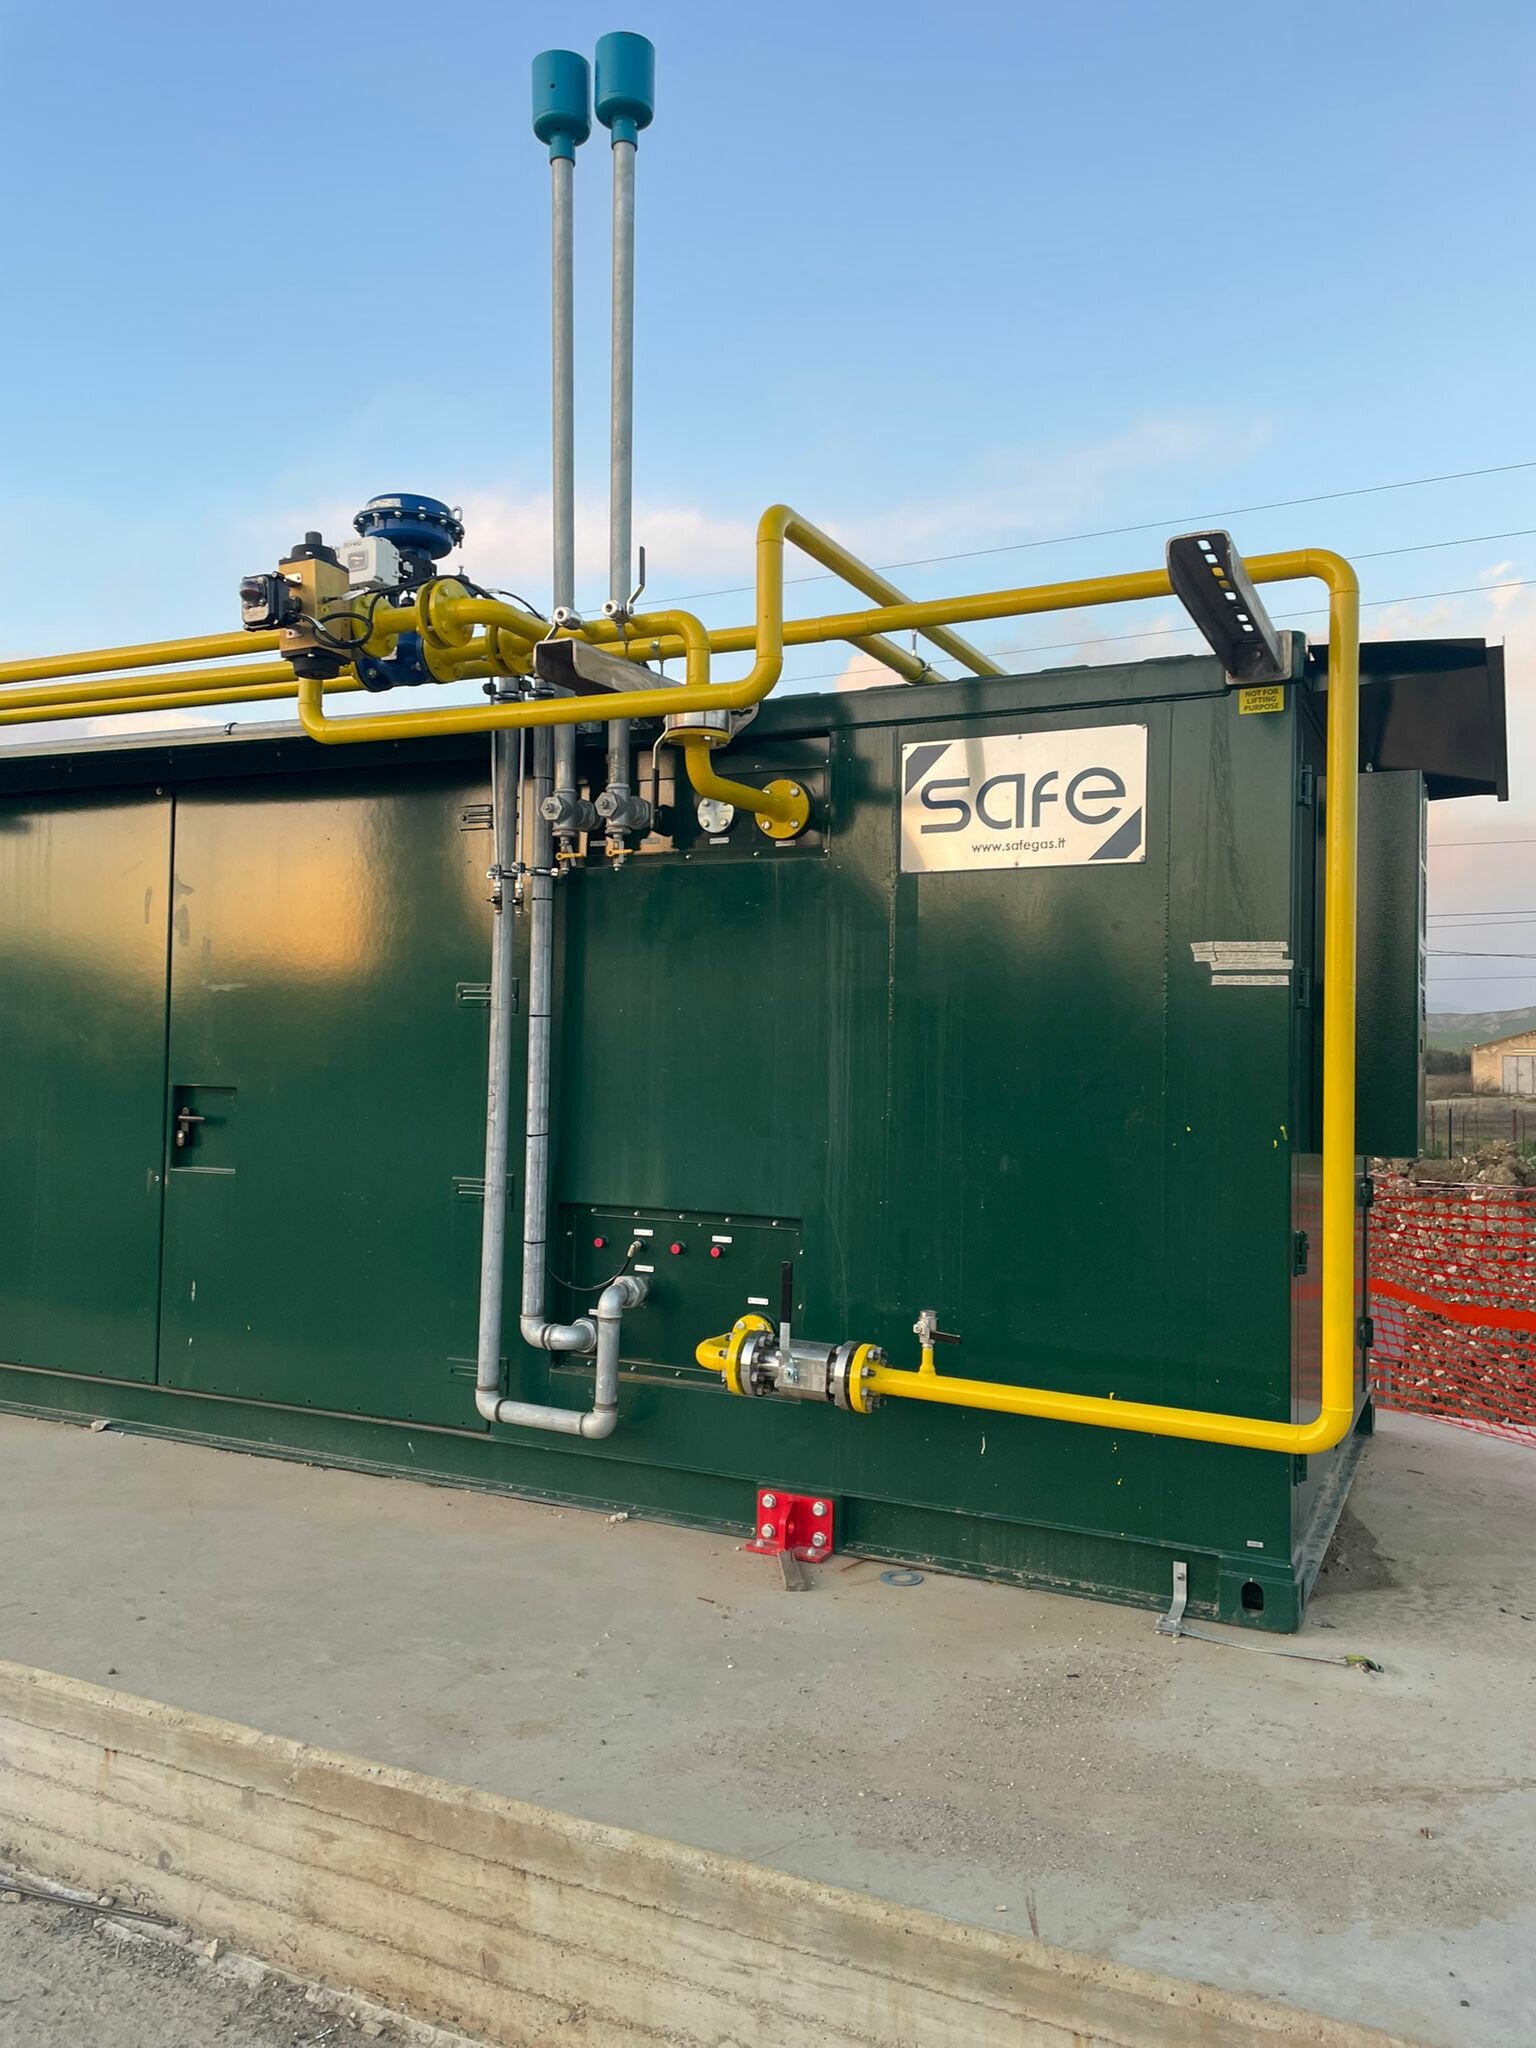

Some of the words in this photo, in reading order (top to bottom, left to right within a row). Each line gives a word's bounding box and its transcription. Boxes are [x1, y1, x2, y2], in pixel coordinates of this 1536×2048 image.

[1262, 688, 1279, 696] FOR
[1246, 696, 1277, 704] LIFTING
[1243, 703, 1279, 711] PURPOSE
[920, 766, 1126, 834] safe
[971, 838, 1066, 853] www.safegas.it
